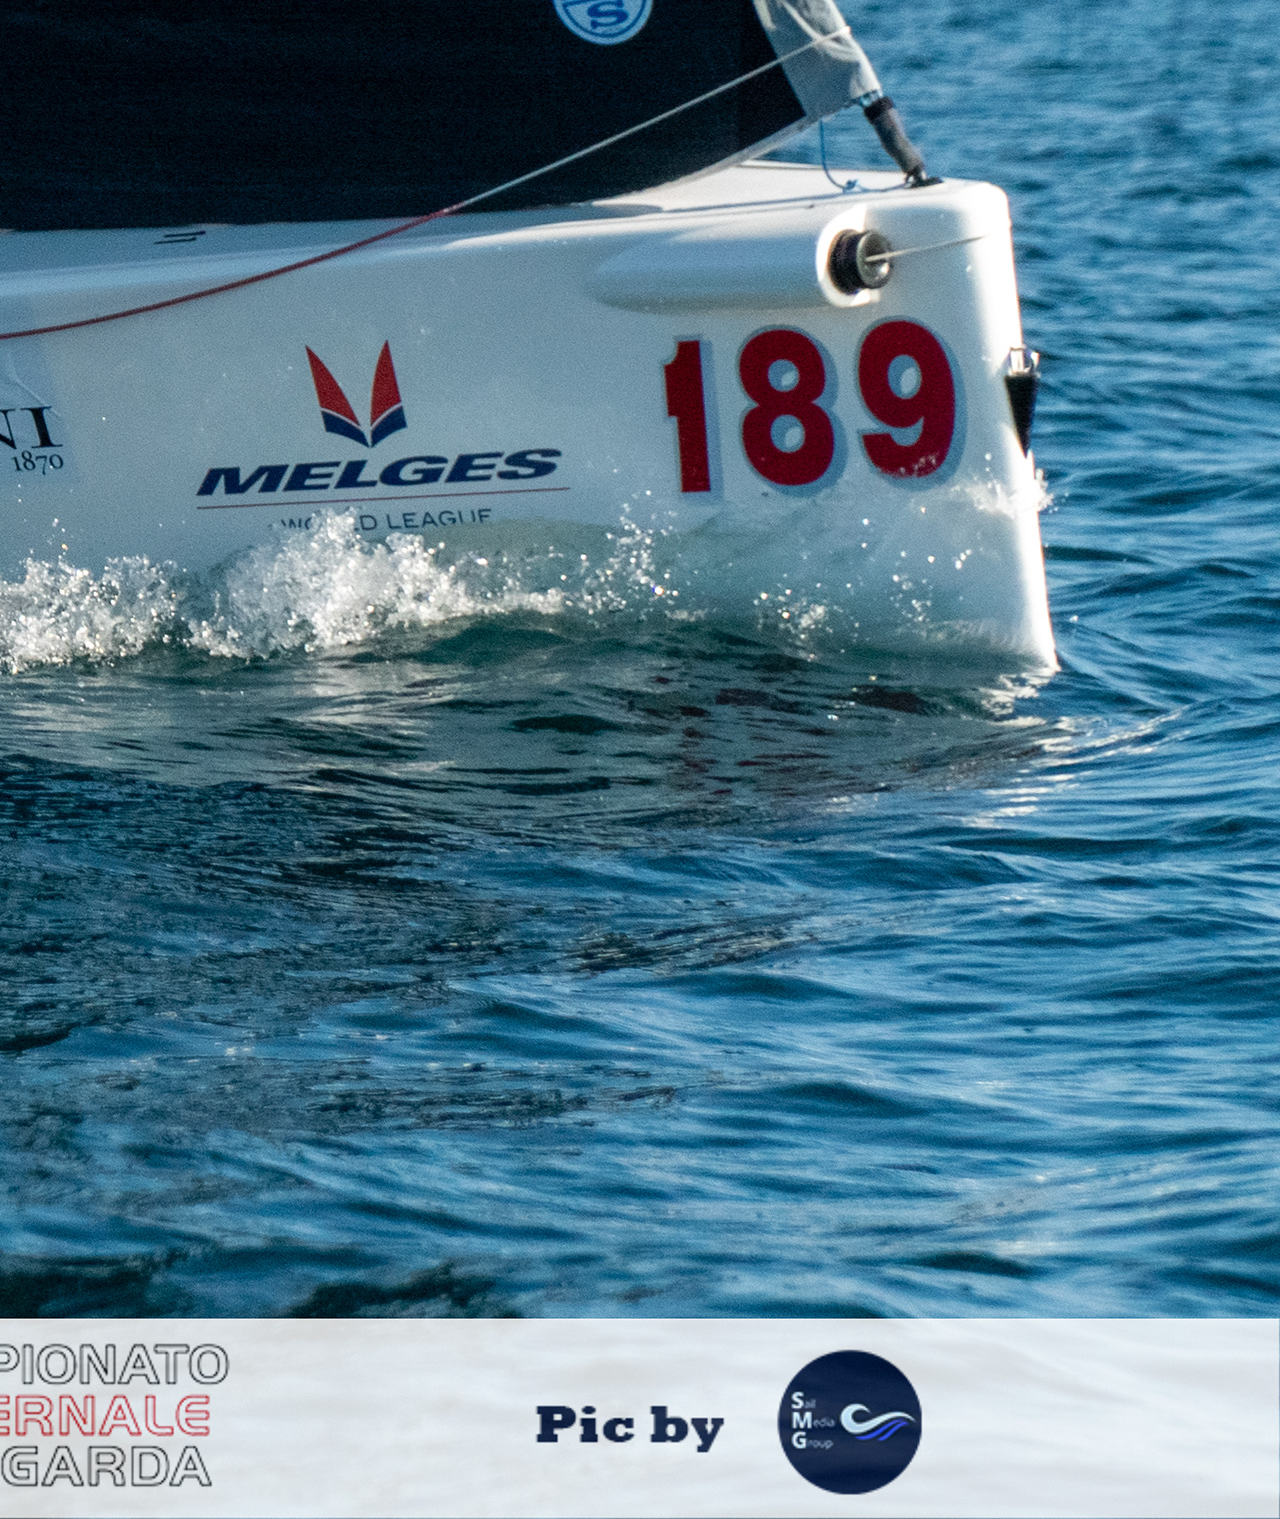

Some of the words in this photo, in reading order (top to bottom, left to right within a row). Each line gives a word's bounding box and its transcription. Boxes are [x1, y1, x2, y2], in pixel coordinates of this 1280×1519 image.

[662, 318, 962, 495] 189
[11, 449, 64, 475] 1870
[196, 448, 562, 497] MELGES
